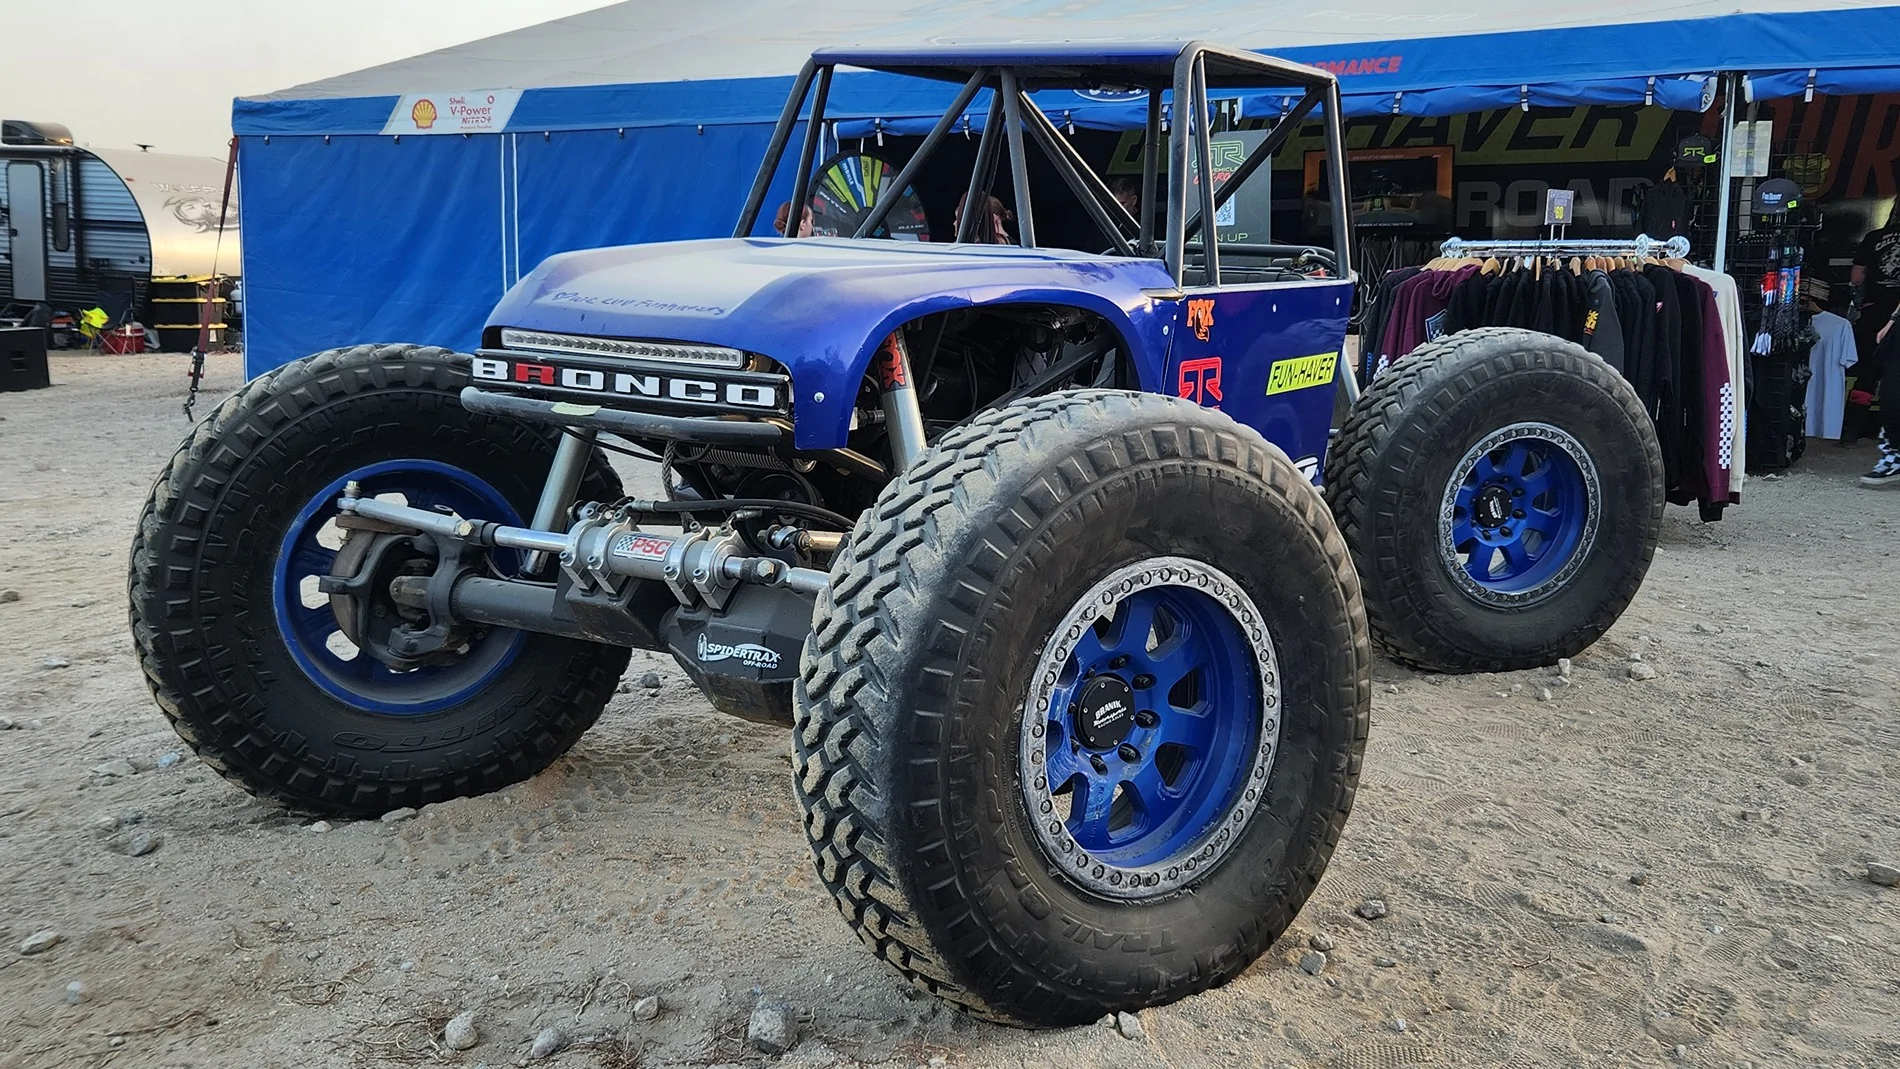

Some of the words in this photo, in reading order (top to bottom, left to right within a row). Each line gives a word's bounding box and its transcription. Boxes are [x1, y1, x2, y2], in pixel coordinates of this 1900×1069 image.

[449, 97, 466, 105] Shell
[450, 106, 492, 116] V-Power
[1228, 233, 1249, 242] UP
[1186, 299, 1216, 330] FOX
[1269, 356, 1334, 389] FUN-HAVER
[472, 358, 776, 407] BRONCO
[631, 538, 671, 555] PSC
[706, 642, 782, 663] SPIDERTRAX
[742, 659, 778, 669] OFF-ROAD
[1095, 700, 1121, 720] BRANIK
